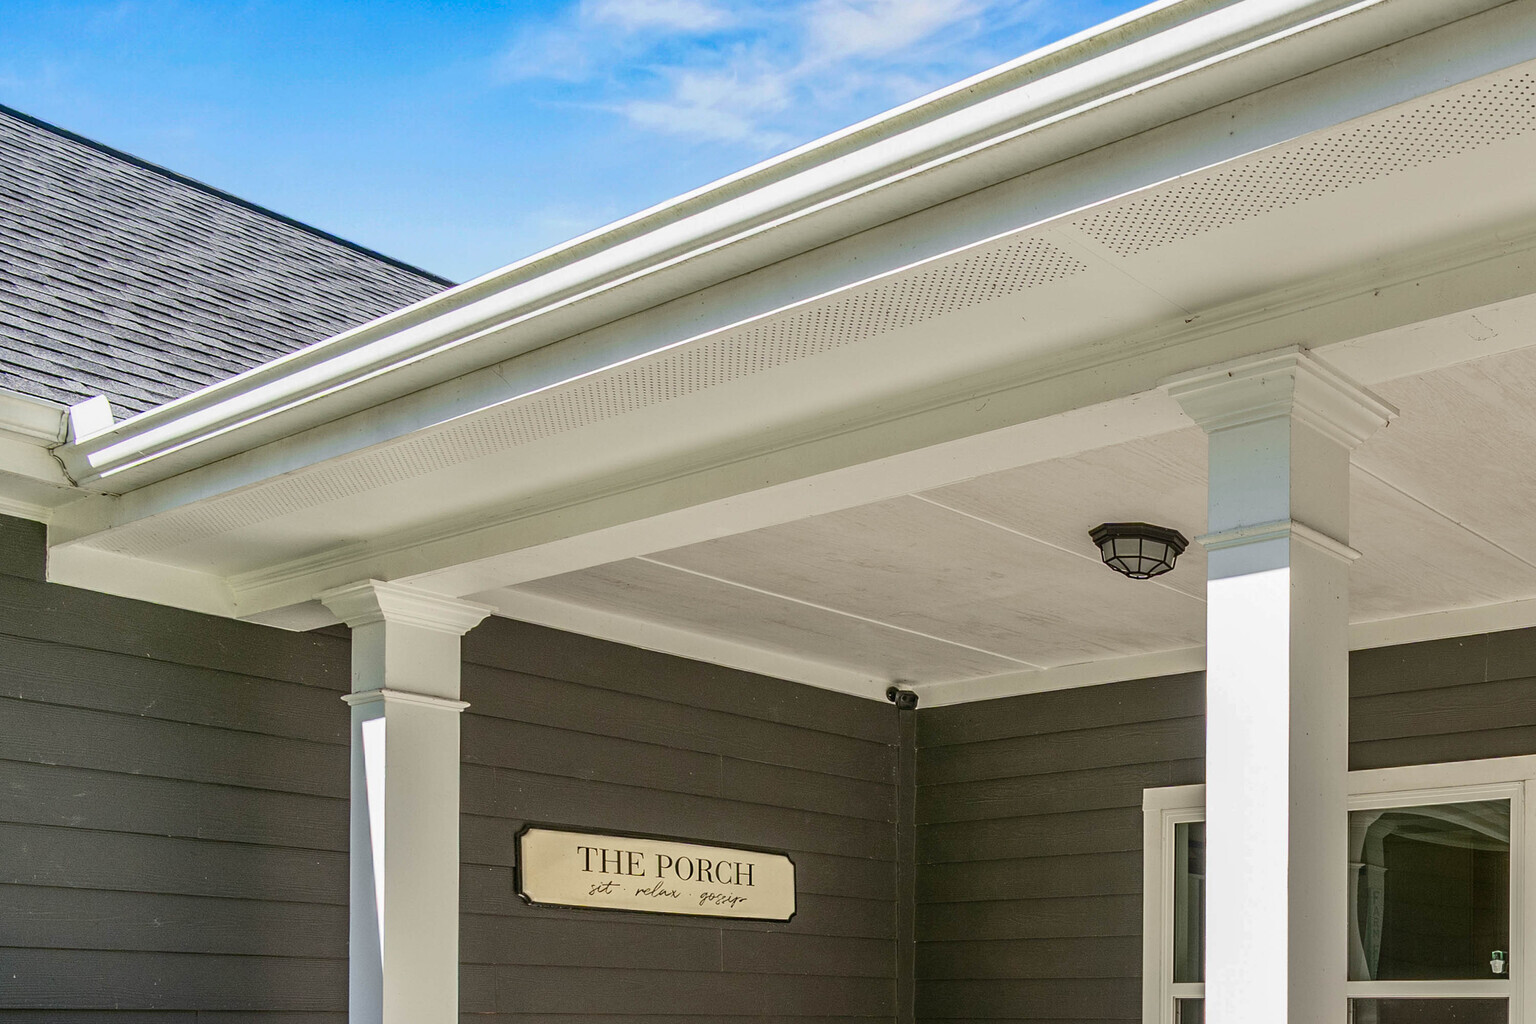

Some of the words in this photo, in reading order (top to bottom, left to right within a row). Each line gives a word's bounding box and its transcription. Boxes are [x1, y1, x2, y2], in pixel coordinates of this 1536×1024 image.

[577, 846, 646, 877] THE
[655, 853, 756, 887] PORCH
[589, 880, 620, 896] sit
[635, 880, 681, 899] relax
[699, 891, 748, 907] gossip
